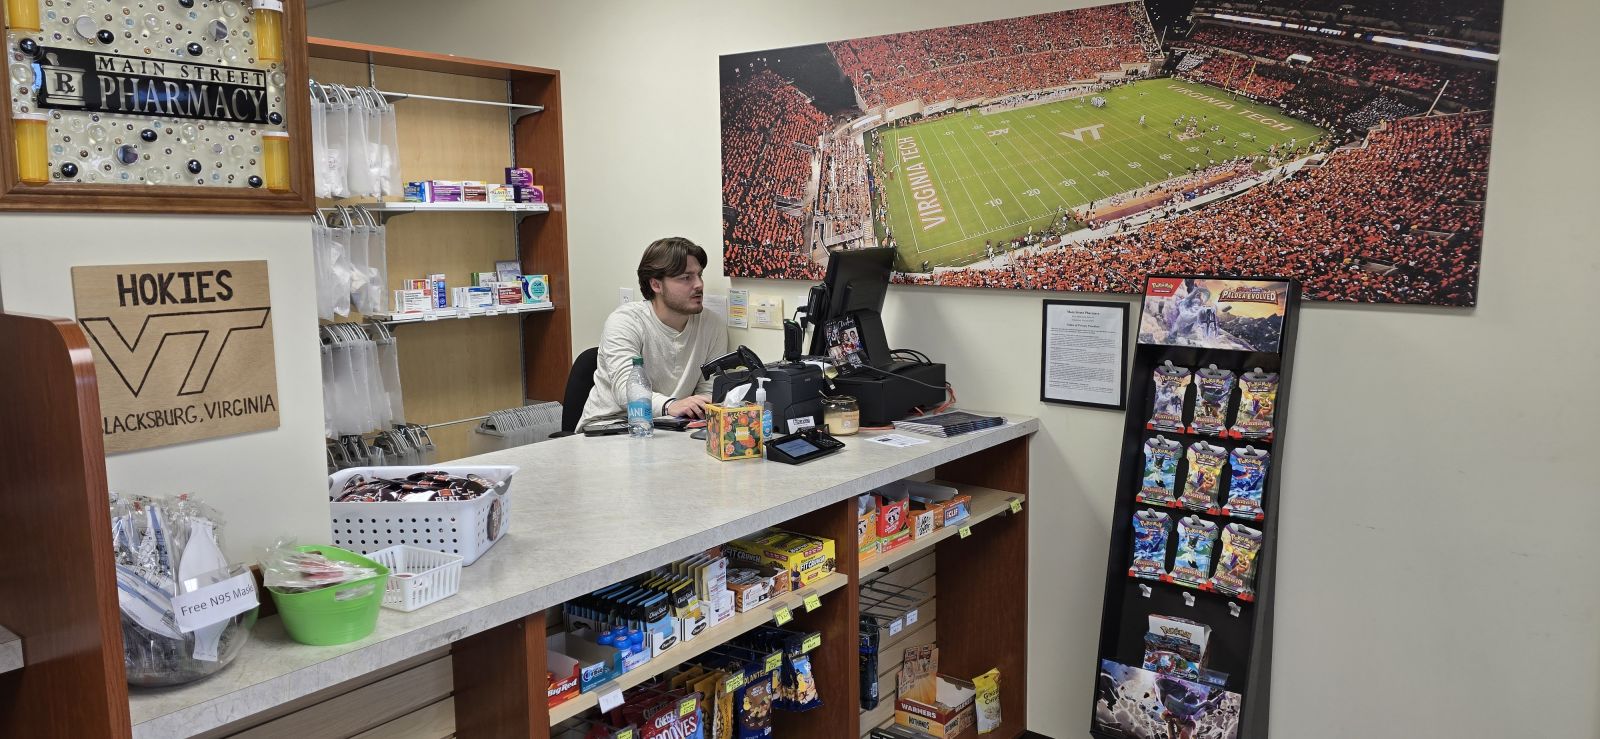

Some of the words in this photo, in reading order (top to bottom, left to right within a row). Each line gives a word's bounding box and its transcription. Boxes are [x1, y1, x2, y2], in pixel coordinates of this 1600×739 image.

[98, 56, 166, 76] MAIN
[180, 64, 264, 87] STREET
[98, 74, 266, 122] PHARMACY
[1167, 84, 1236, 110] VIRGINIA
[1238, 109, 1295, 132] TECH
[1058, 123, 1105, 142] VT
[898, 136, 921, 162] TECH
[906, 162, 946, 232] VIRGINIA
[116, 269, 233, 307] HOKIES
[1222, 290, 1246, 299] PALDEA
[1247, 292, 1276, 301] EVOLVED
[79, 306, 271, 398] VT
[100, 405, 204, 436] LACKSBURG,
[738, 550, 761, 563] CRUNCH
[800, 563, 808, 573] FIT
[180, 602, 207, 616] Free
[209, 592, 231, 607] N95
[547, 688, 562, 697] Big
[561, 678, 577, 691] Red
